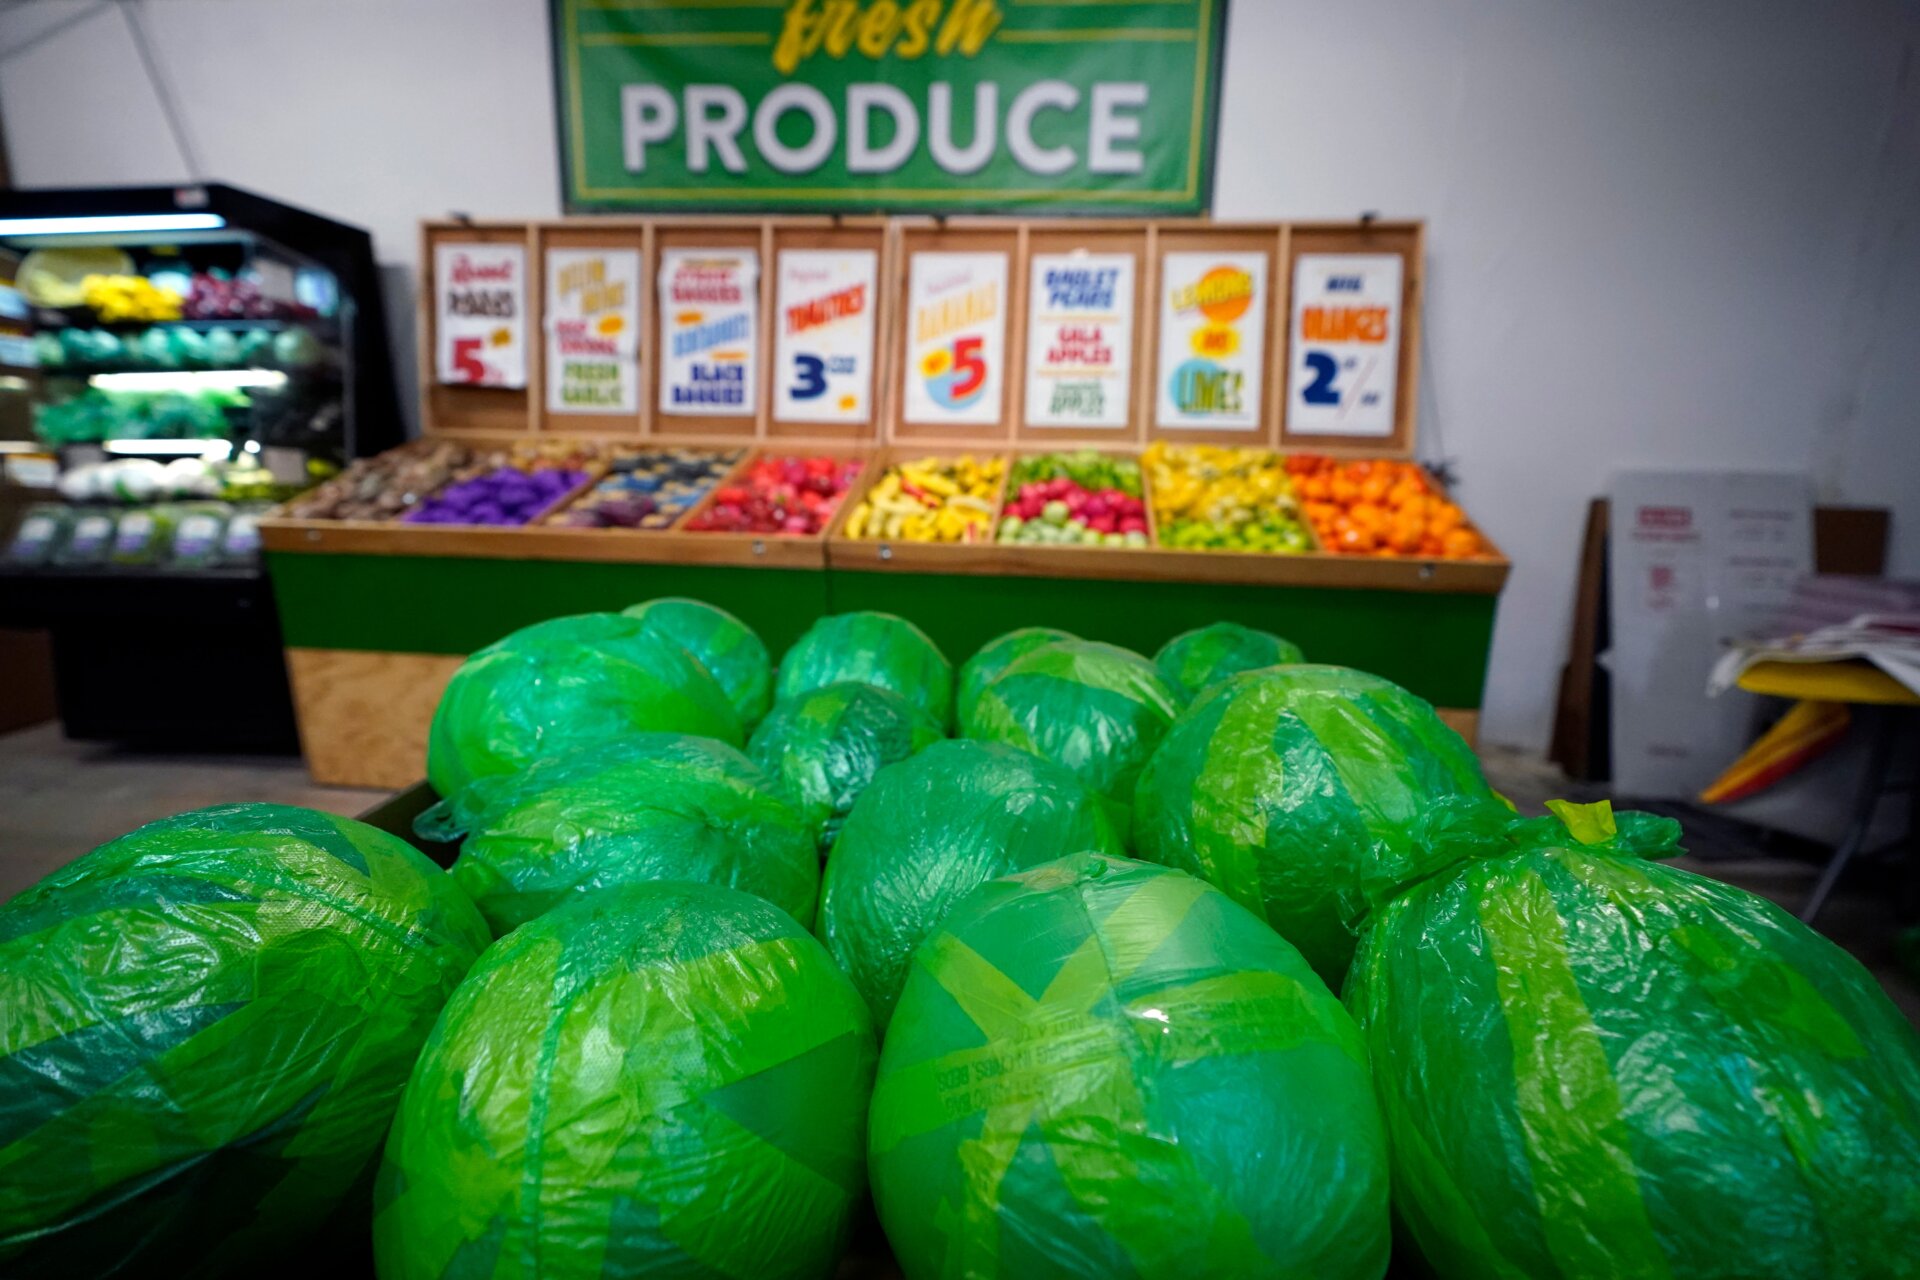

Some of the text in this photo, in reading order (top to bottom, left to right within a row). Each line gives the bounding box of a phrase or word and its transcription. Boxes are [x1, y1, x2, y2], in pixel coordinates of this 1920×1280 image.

[620, 81, 1149, 174] PRODUCE
[454, 338, 485, 382] 5
[790, 353, 827, 400] 3
[951, 337, 987, 400] 5
[1301, 350, 1342, 406] 2
